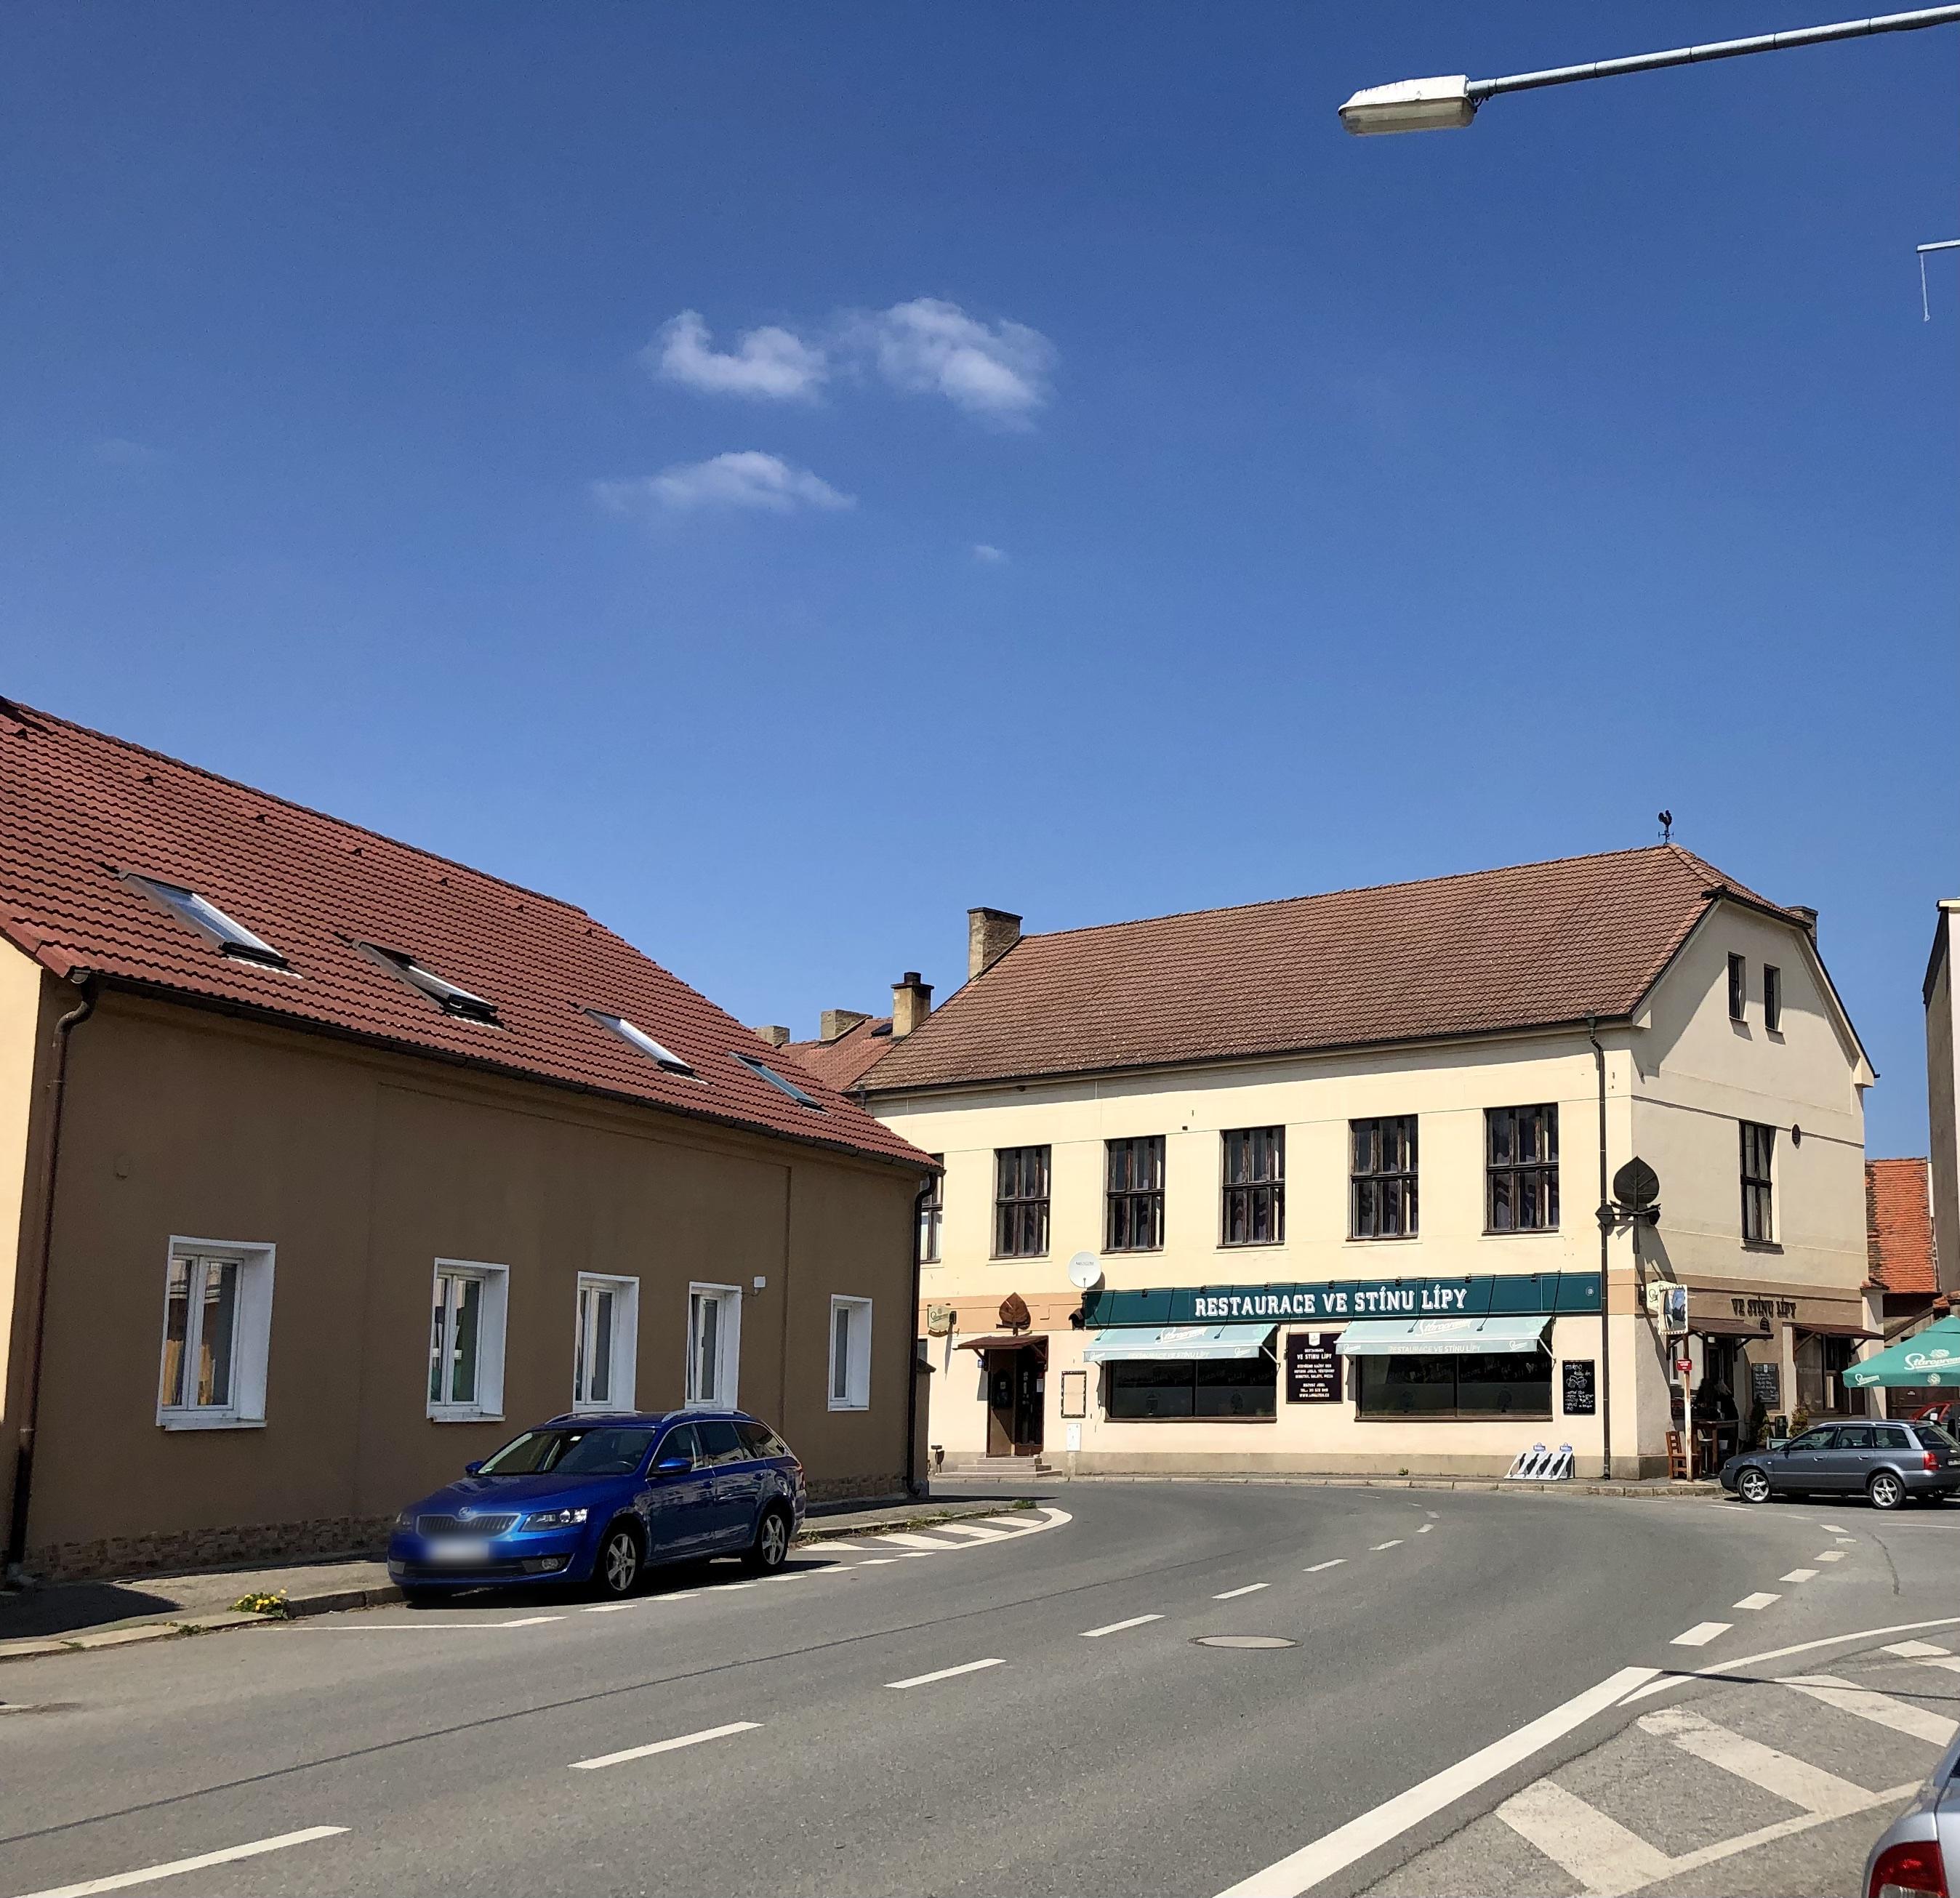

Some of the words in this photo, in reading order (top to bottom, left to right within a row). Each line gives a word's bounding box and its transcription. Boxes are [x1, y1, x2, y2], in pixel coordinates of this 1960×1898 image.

[1194, 1294, 1316, 1316] RESTAURACE
[1322, 1292, 1348, 1313] VE
[1354, 1285, 1415, 1312] STÍNU
[1421, 1284, 1468, 1310] LÍPY
[1731, 1298, 1745, 1316] VE
[1747, 1295, 1774, 1319] STÍNU
[1388, 1346, 1431, 1354] RESTAURACE
[1445, 1343, 1465, 1353] STÍNU
[1466, 1343, 1481, 1352] LÍPY
